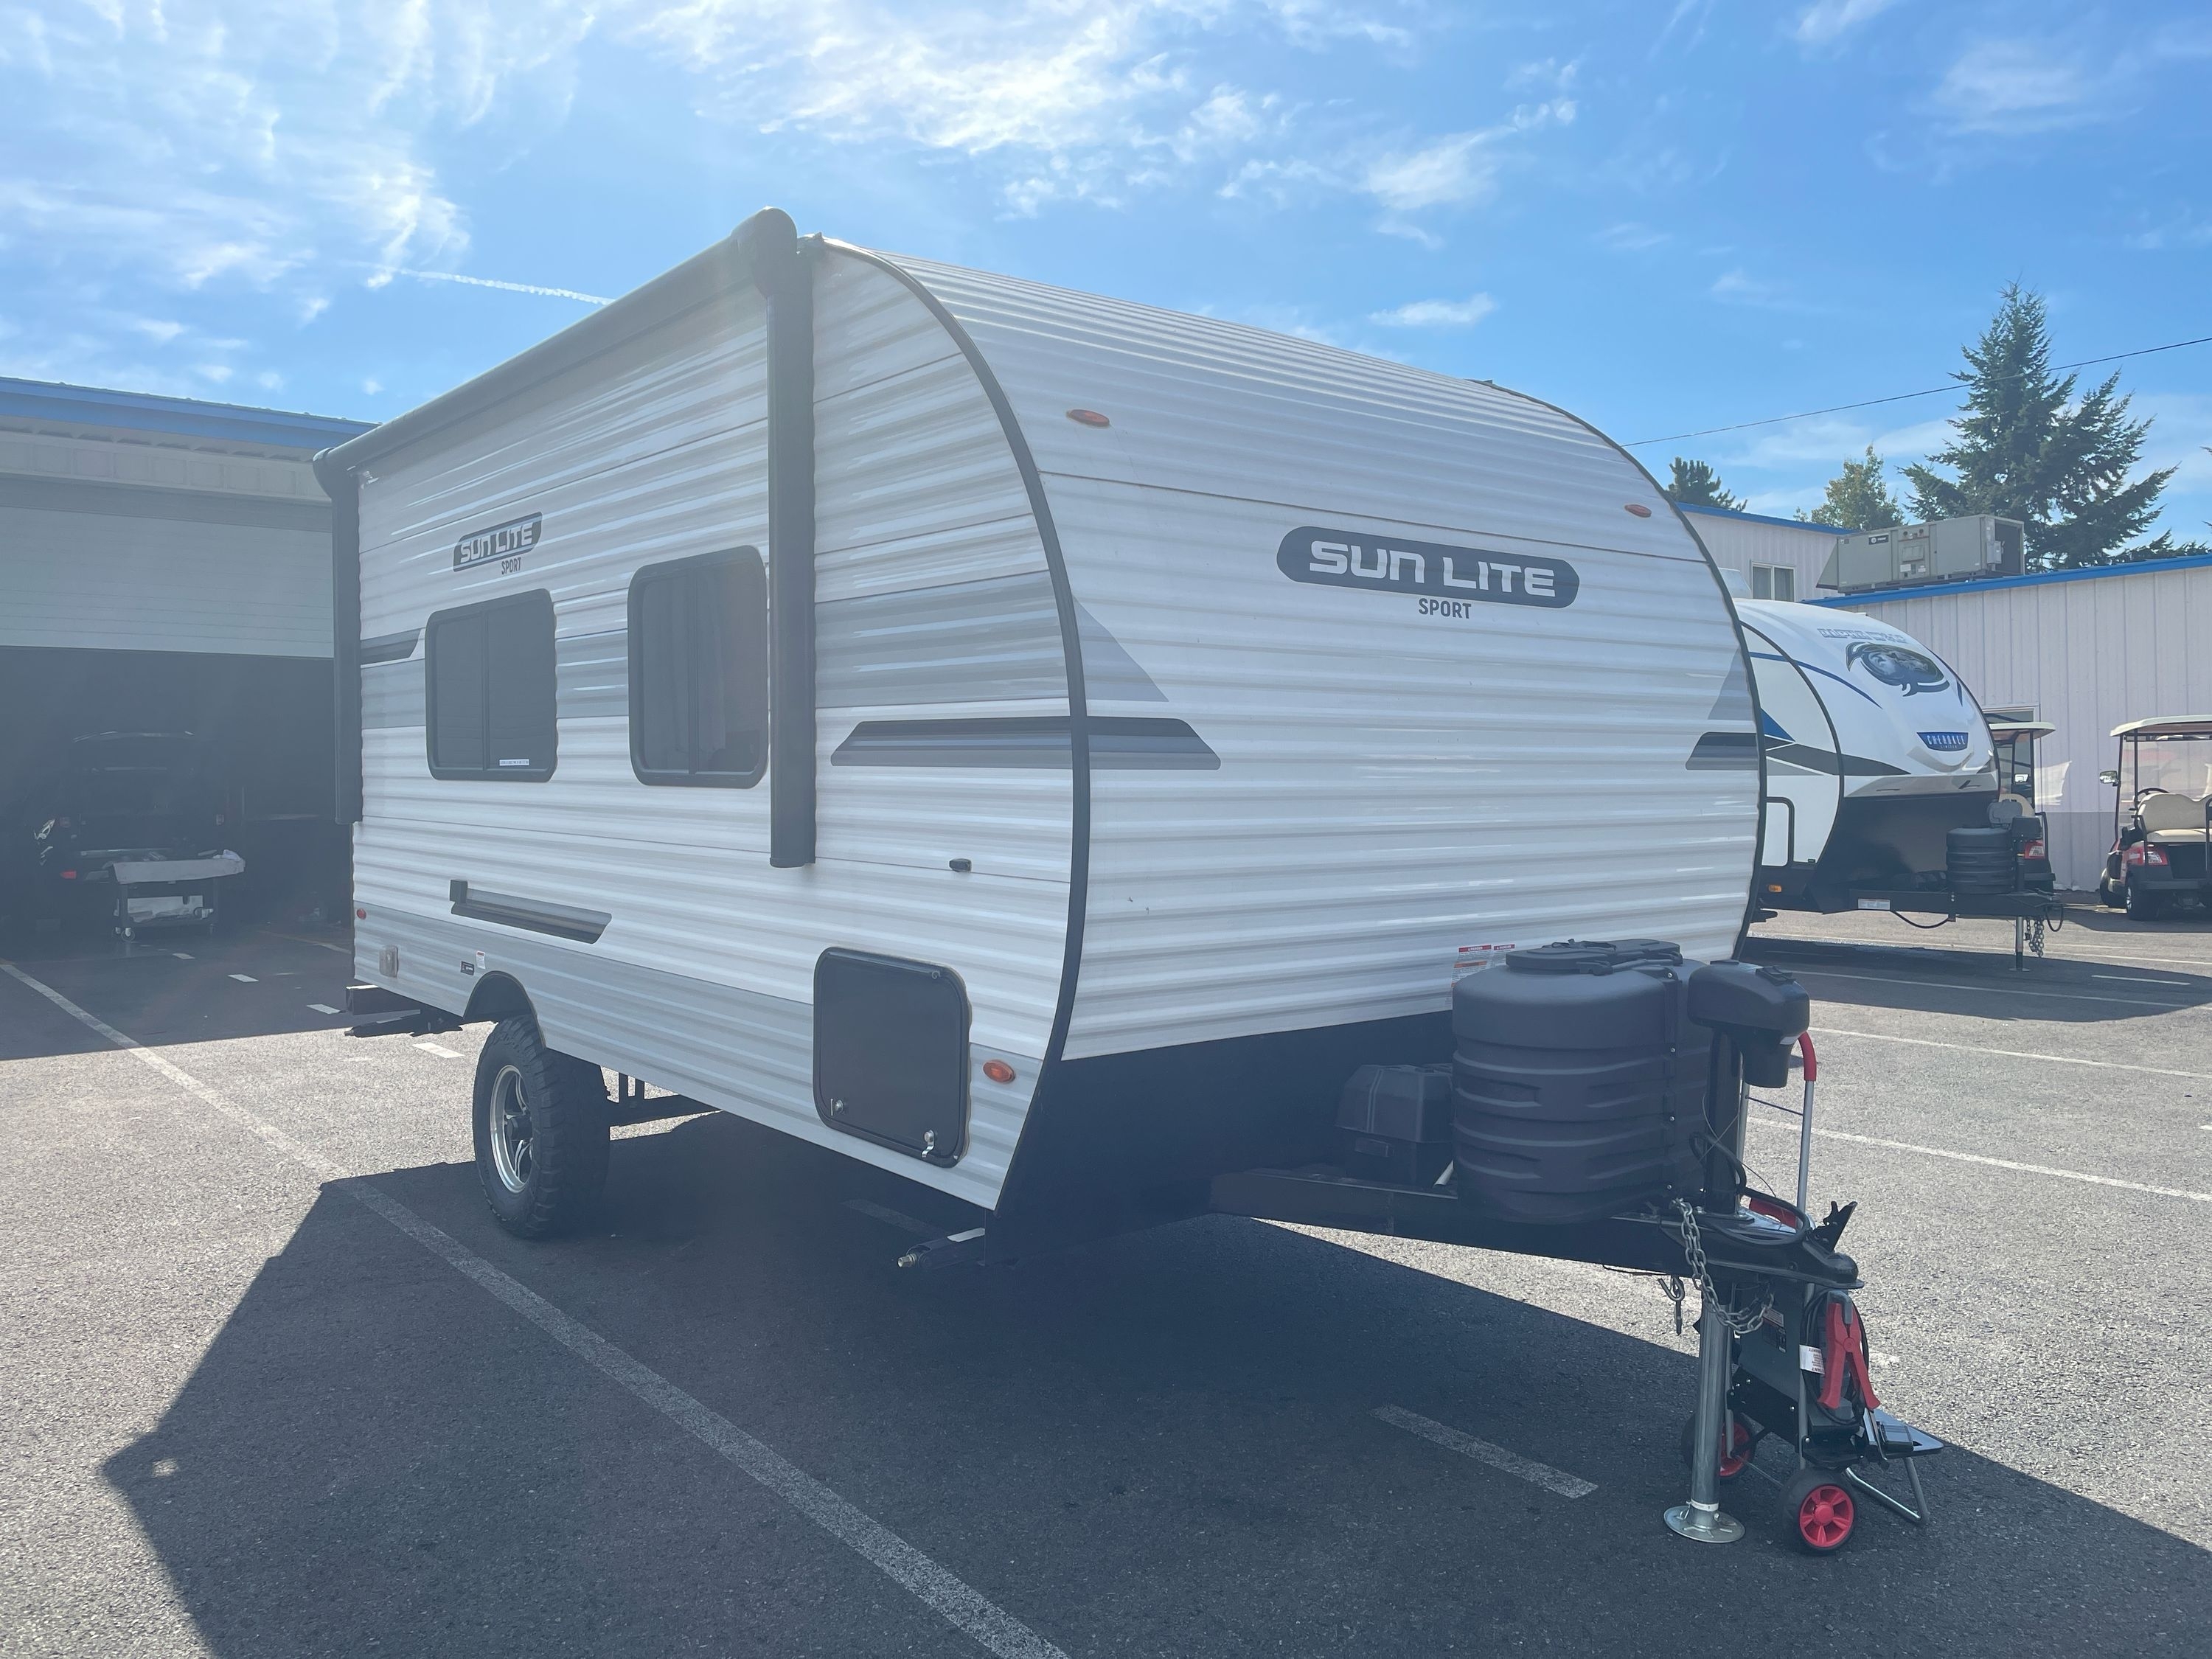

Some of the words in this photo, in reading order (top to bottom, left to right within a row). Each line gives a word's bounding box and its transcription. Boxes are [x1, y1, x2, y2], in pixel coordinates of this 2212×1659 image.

[460, 535, 491, 563] SUN
[495, 522, 534, 554] LITE
[501, 557, 522, 575] SPORT
[1309, 540, 1426, 584] SUN
[1441, 555, 1557, 598] LITE
[1418, 597, 1472, 619] SPORT
